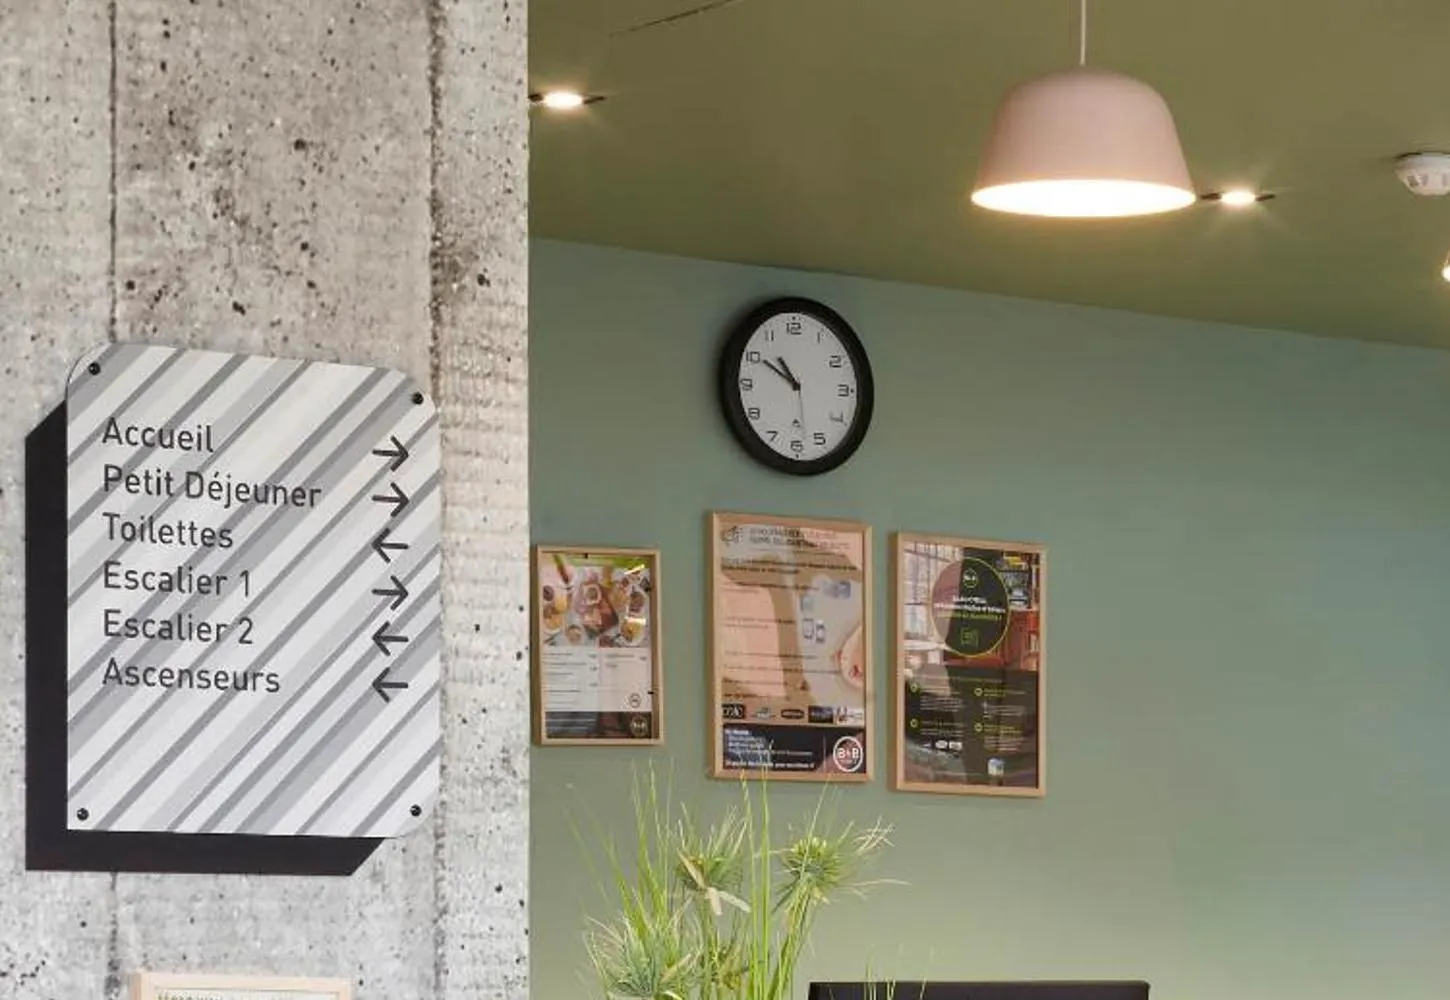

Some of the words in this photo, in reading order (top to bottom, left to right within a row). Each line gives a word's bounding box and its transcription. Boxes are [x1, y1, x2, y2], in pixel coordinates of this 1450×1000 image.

[787, 322, 801, 335] 12
[746, 350, 761, 364] 10
[829, 355, 842, 369] 2
[740, 378, 753, 391] 9
[838, 383, 849, 398] 3
[748, 407, 760, 420] 8
[101, 417, 214, 453] Accueil
[766, 430, 778, 442] 7
[813, 432, 827, 446] 5
[790, 440, 804, 453] 6
[103, 464, 174, 499] Petit
[185, 470, 322, 508] Déjeuner
[102, 512, 234, 549] Toilettes
[103, 560, 228, 597] Escalier
[239, 569, 251, 598] 1
[103, 608, 228, 645] Escalier
[238, 617, 254, 645] 2
[101, 658, 281, 694] Ascenseurs
